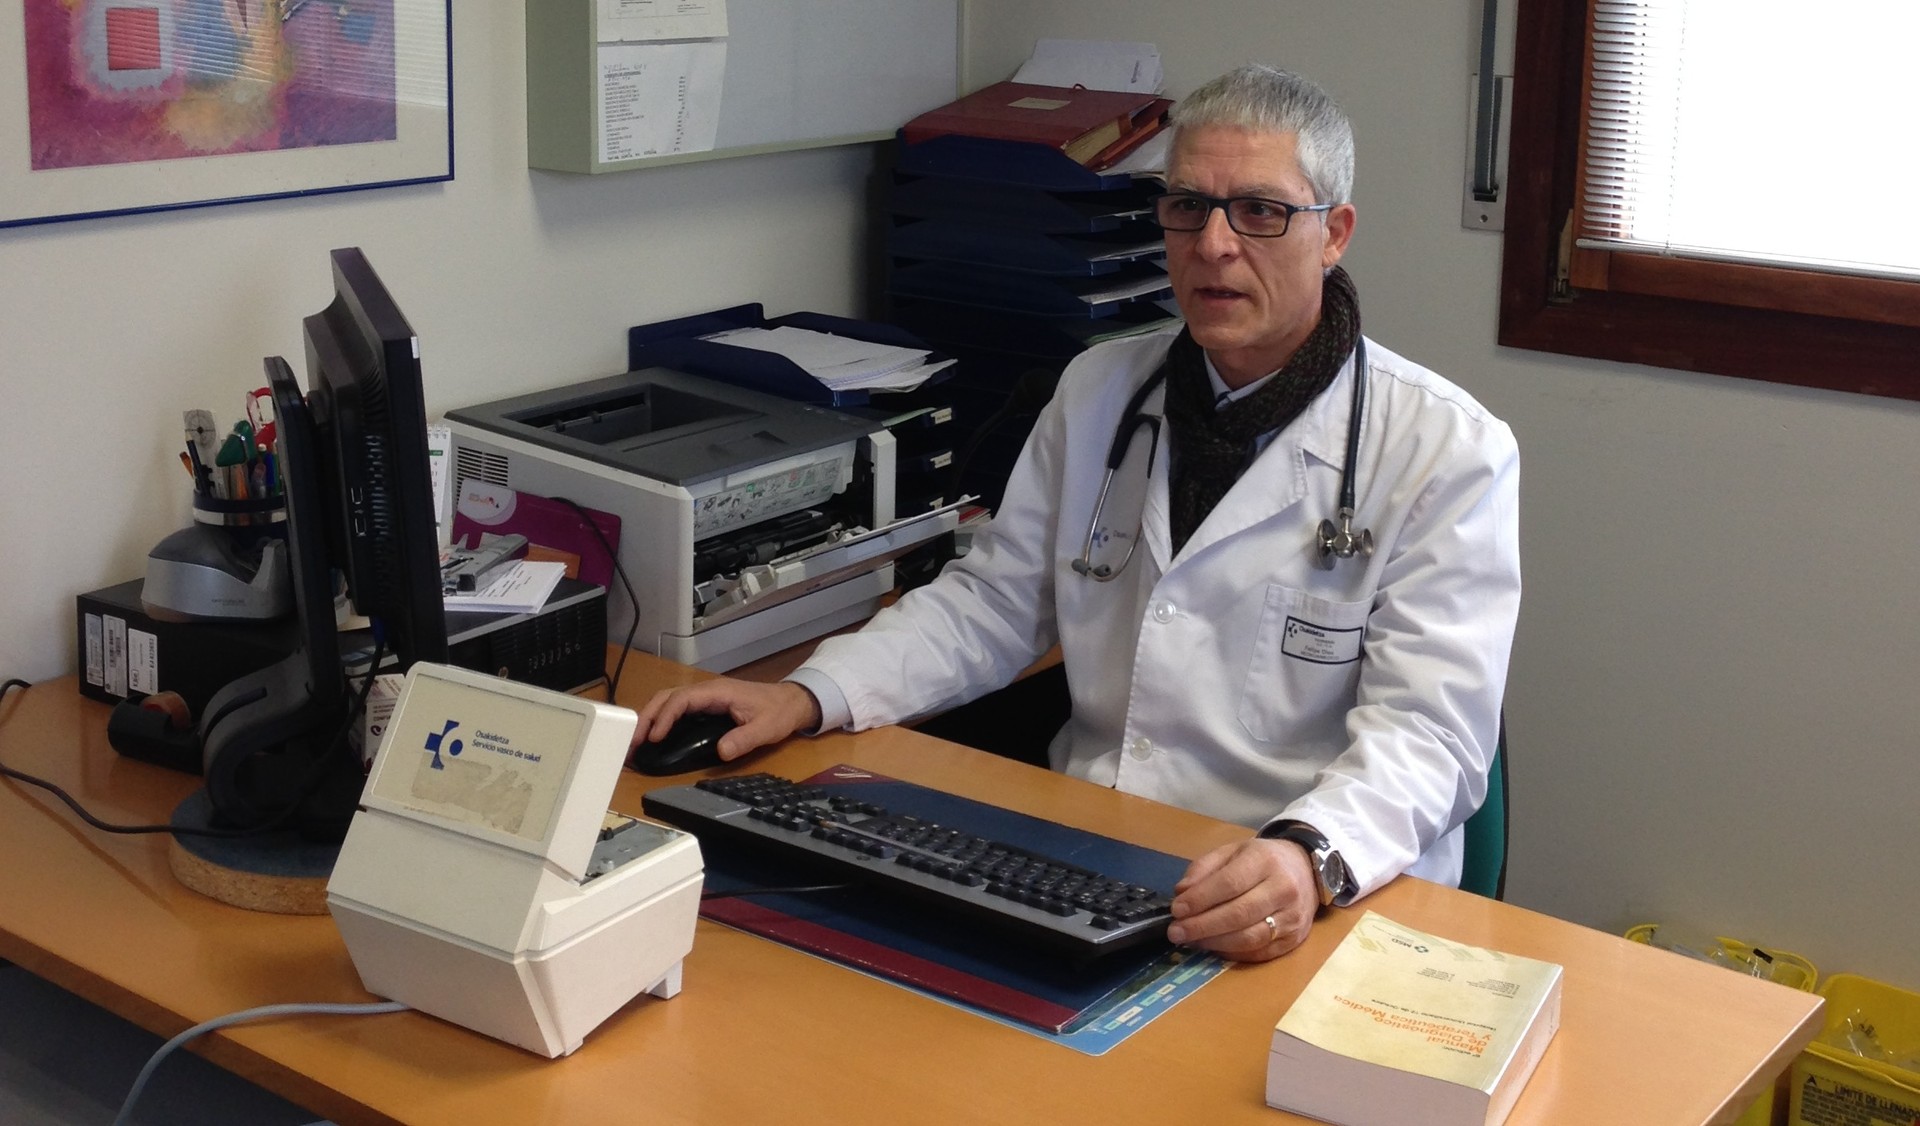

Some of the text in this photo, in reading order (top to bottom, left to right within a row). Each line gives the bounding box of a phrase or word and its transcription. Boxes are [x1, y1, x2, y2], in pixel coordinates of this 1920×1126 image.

[475, 729, 510, 745] Osakidetza
[472, 739, 542, 763] Servicio vasco de salud
[1391, 938, 1412, 948] MSD
[1468, 1036, 1488, 1047] de
[1482, 1033, 1492, 1041] y
[1426, 1036, 1484, 1054] Manual
[1866, 1094, 1877, 1106] DE
